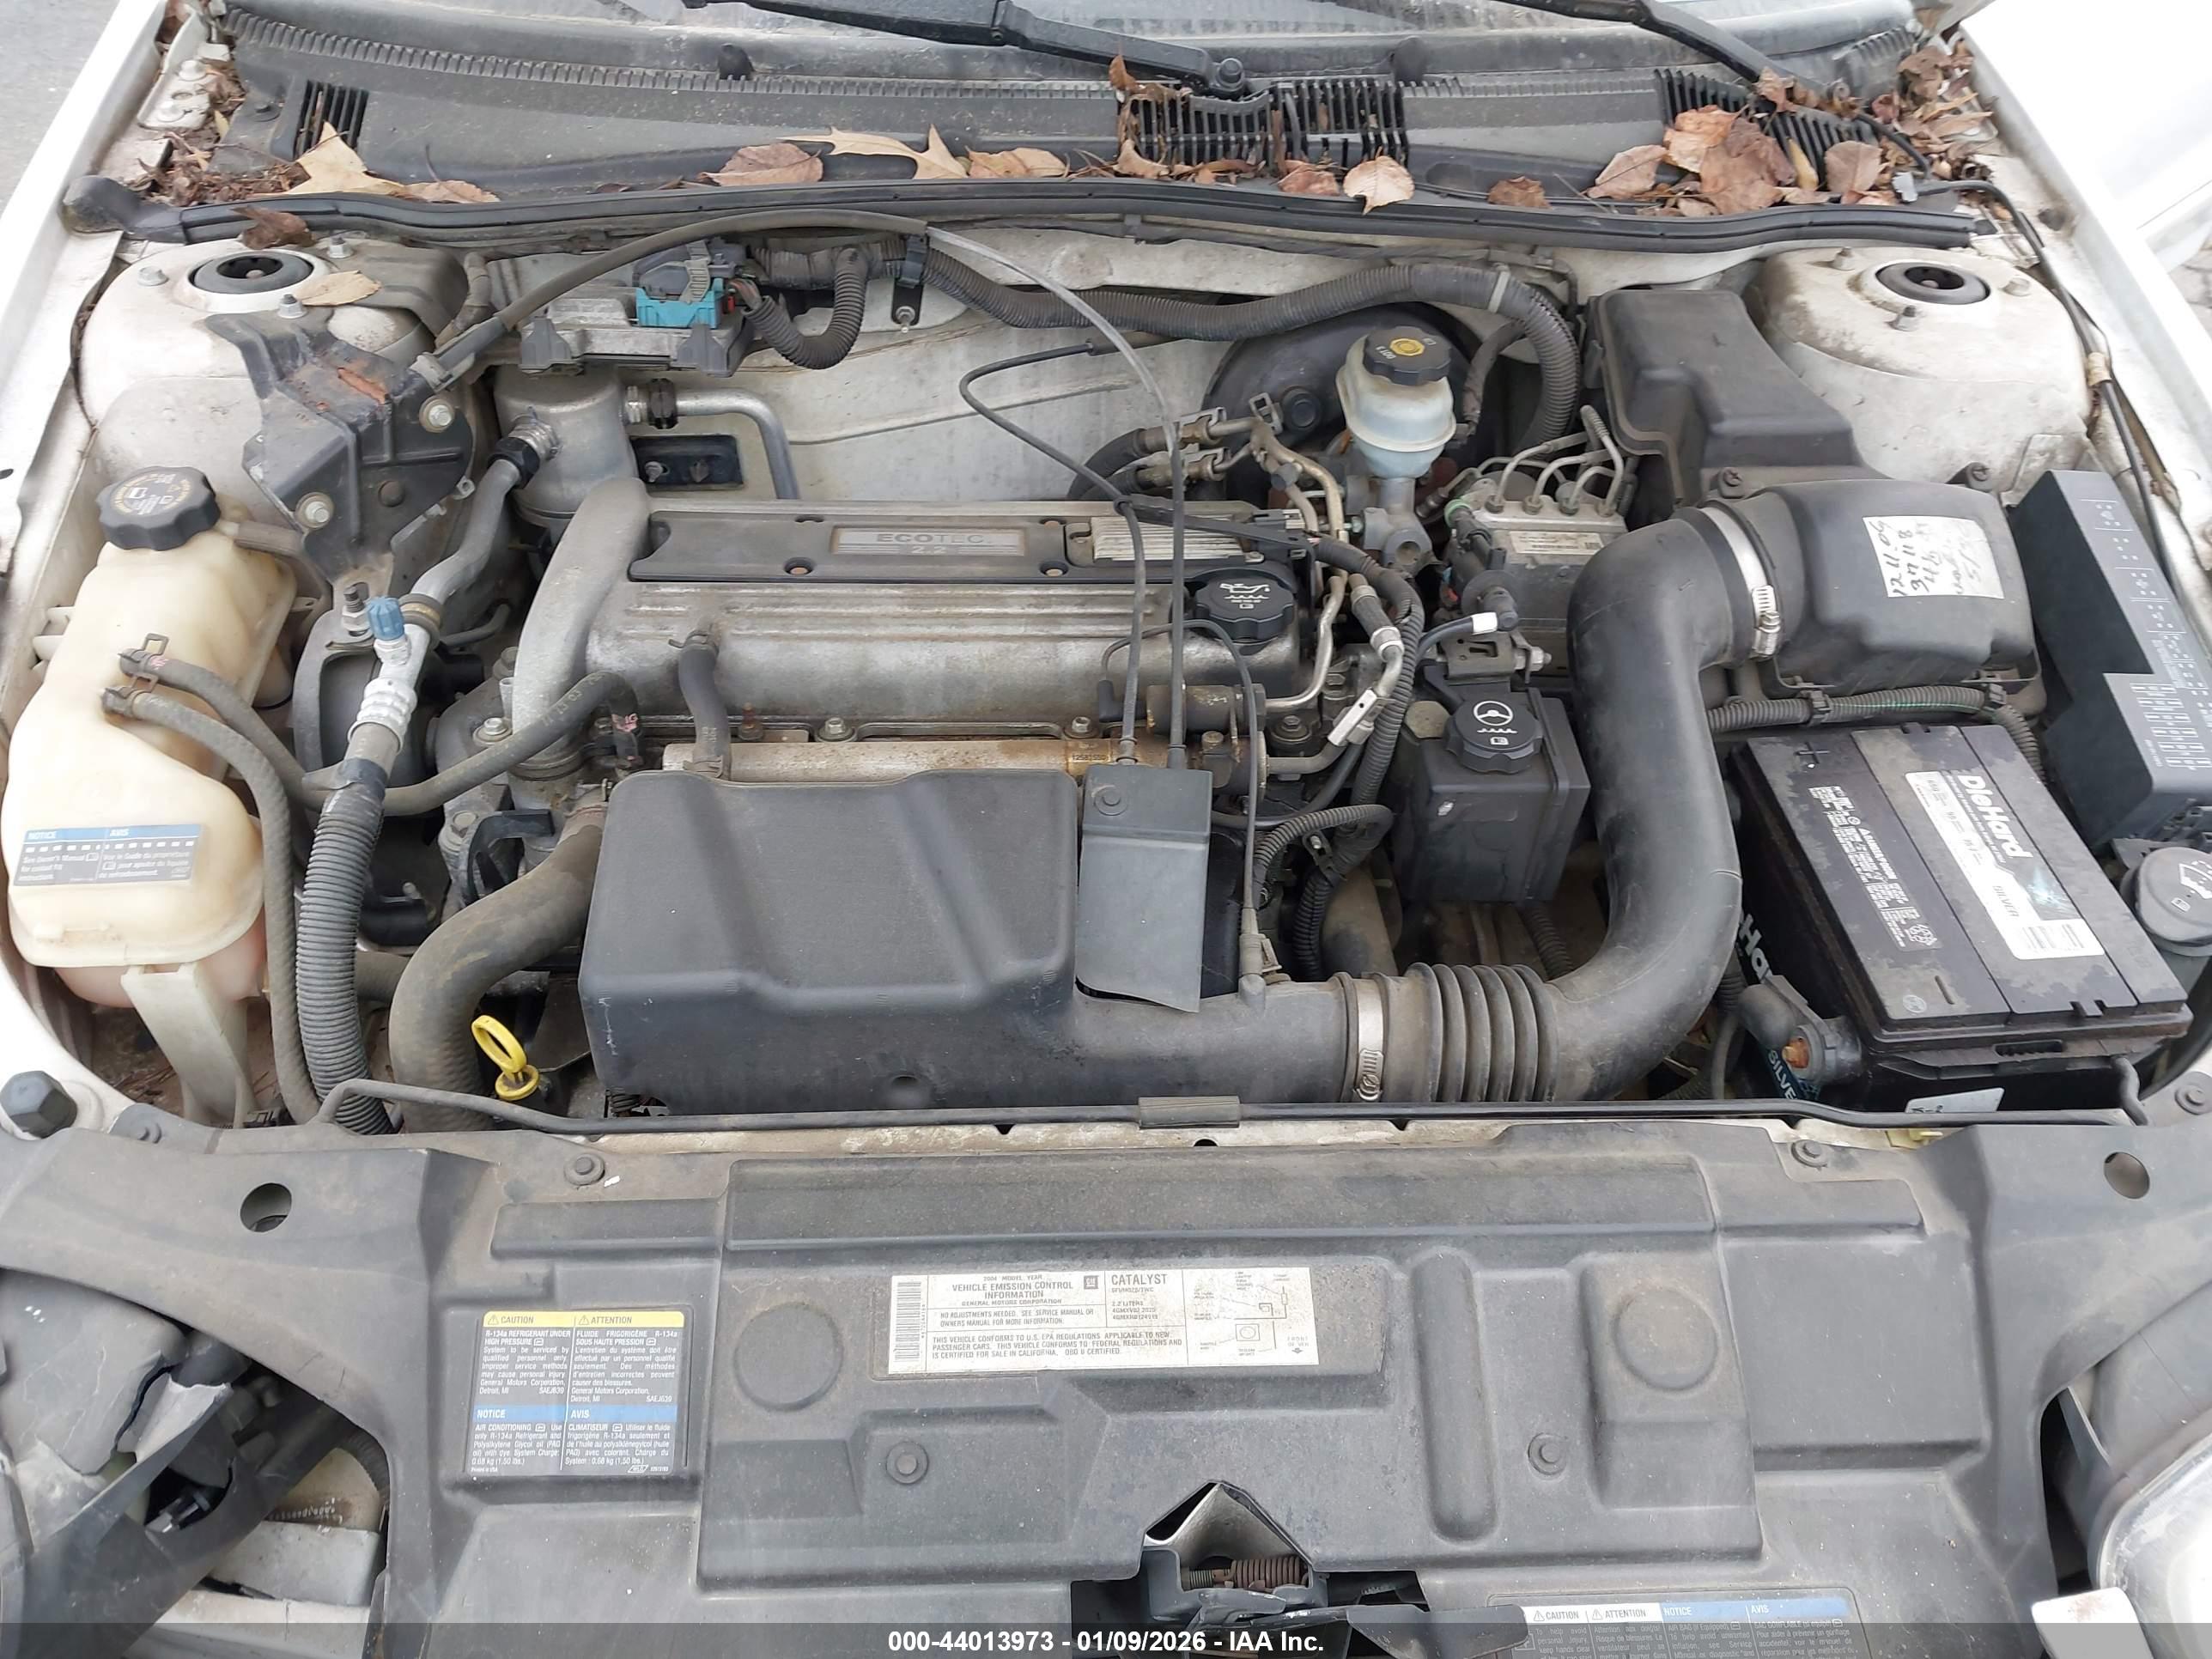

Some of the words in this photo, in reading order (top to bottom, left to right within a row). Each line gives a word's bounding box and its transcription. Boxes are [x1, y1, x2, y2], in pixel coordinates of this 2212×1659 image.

[877, 534, 984, 544] ECOTEC
[912, 545, 946, 554] 2.2
[1957, 774, 2033, 860] DieHard
[1767, 1049, 1798, 1099] SILVE
[1111, 1274, 1168, 1285] CATALYST
[1035, 1281, 1073, 1290] CONTROL
[985, 1291, 1043, 1299] INFORMATION
[477, 1409, 506, 1418] NOTICE
[571, 1409, 590, 1419] AVIS
[1663, 1607, 1692, 1615] NOTICE
[1752, 1605, 1769, 1613] AVIS
[1546, 1611, 1579, 1620] CAUTION
[1605, 1609, 1646, 1619] ATTENTION
